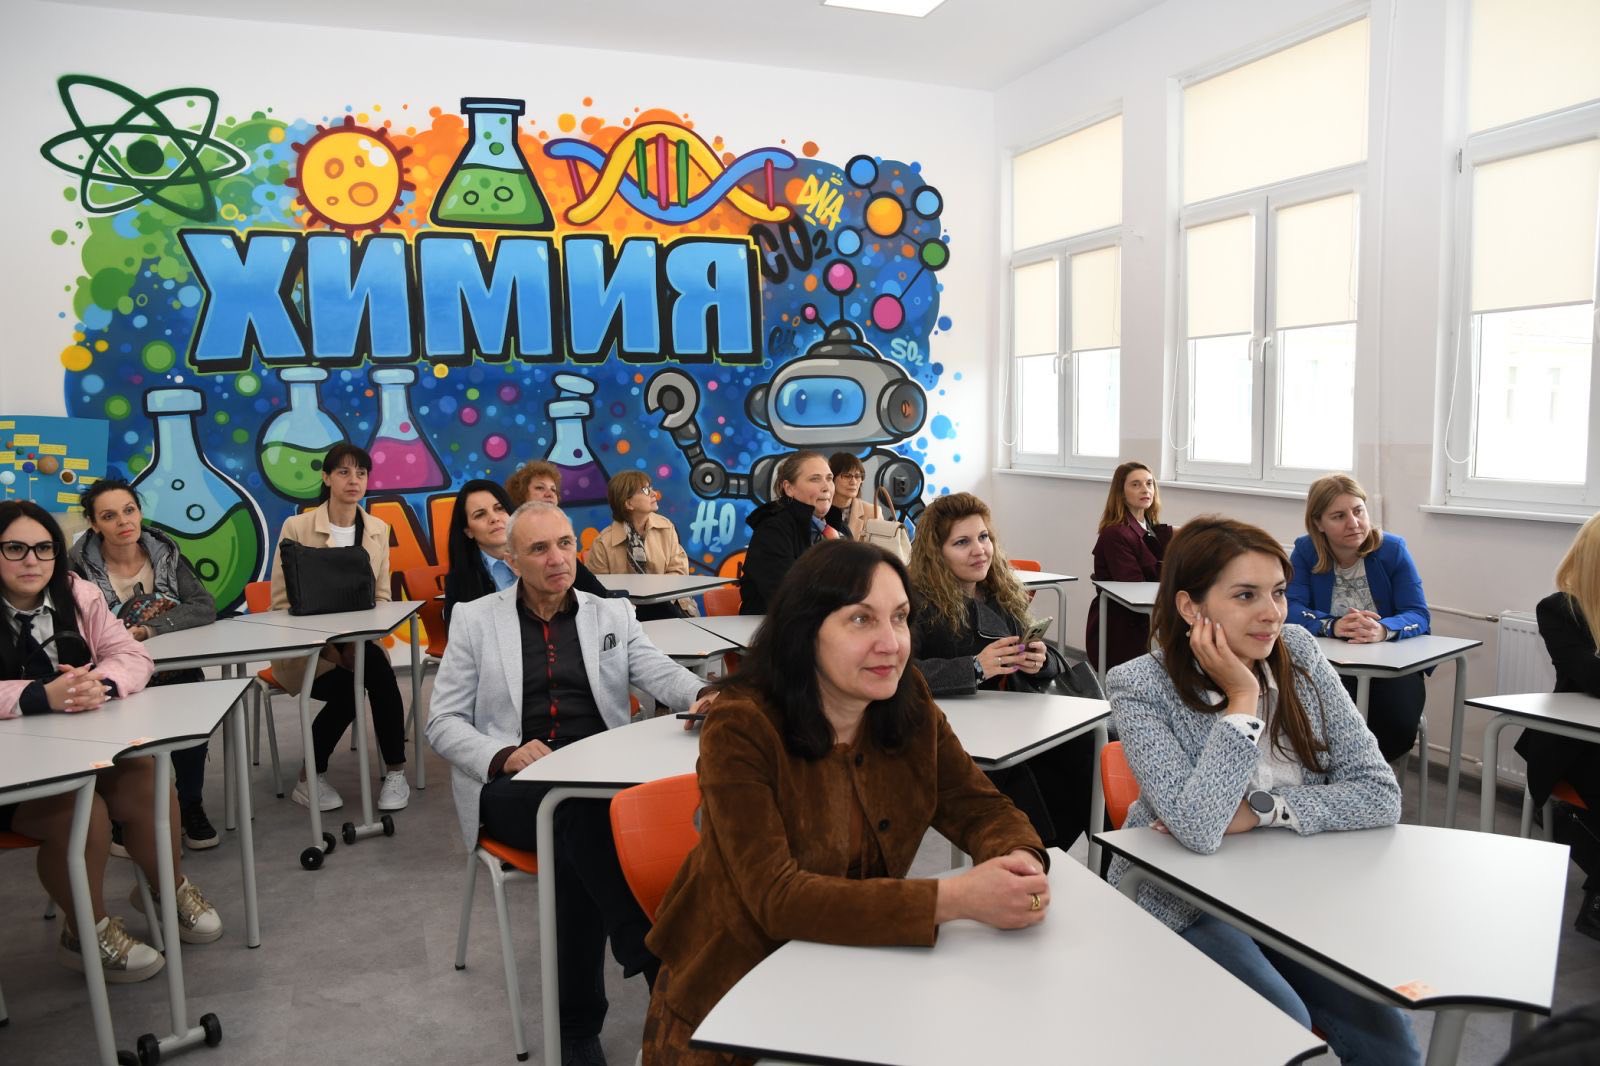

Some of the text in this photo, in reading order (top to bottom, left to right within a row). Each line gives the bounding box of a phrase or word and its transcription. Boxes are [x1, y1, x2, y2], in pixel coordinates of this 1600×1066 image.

[797, 174, 844, 231] DNA
[748, 214, 832, 284] CO2
[182, 229, 763, 370] ХИМИЯ
[890, 337, 924, 366] SO2
